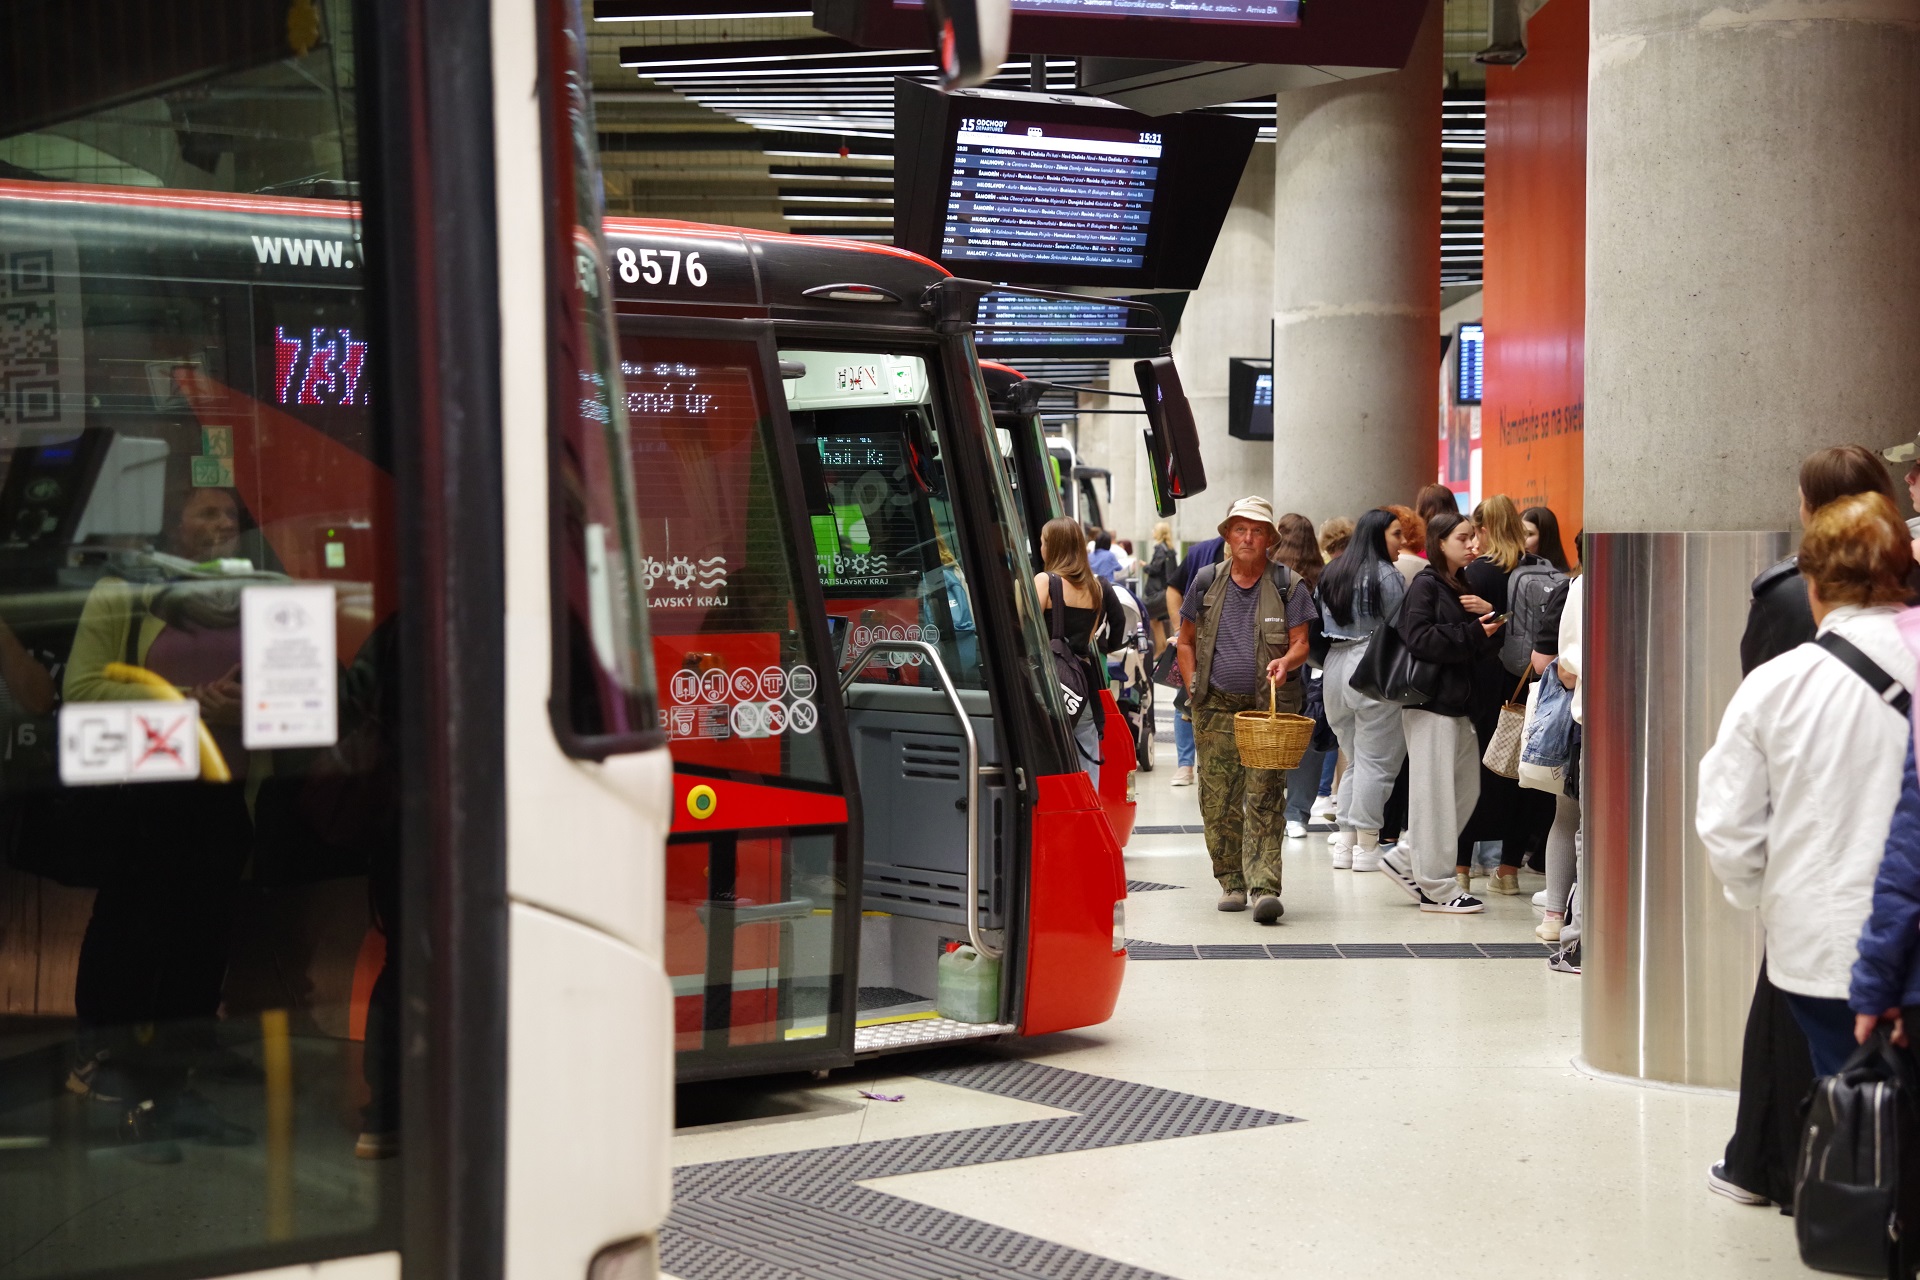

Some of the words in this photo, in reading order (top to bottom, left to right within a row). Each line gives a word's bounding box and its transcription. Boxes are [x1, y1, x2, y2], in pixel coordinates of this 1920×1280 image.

[960, 118, 976, 131] 15
[976, 119, 1008, 128] ODCHODY
[1139, 133, 1162, 144] 15:31
[617, 247, 708, 287] 8576
[646, 594, 693, 608] LAVSKÝ
[697, 596, 729, 606] KRAJ
